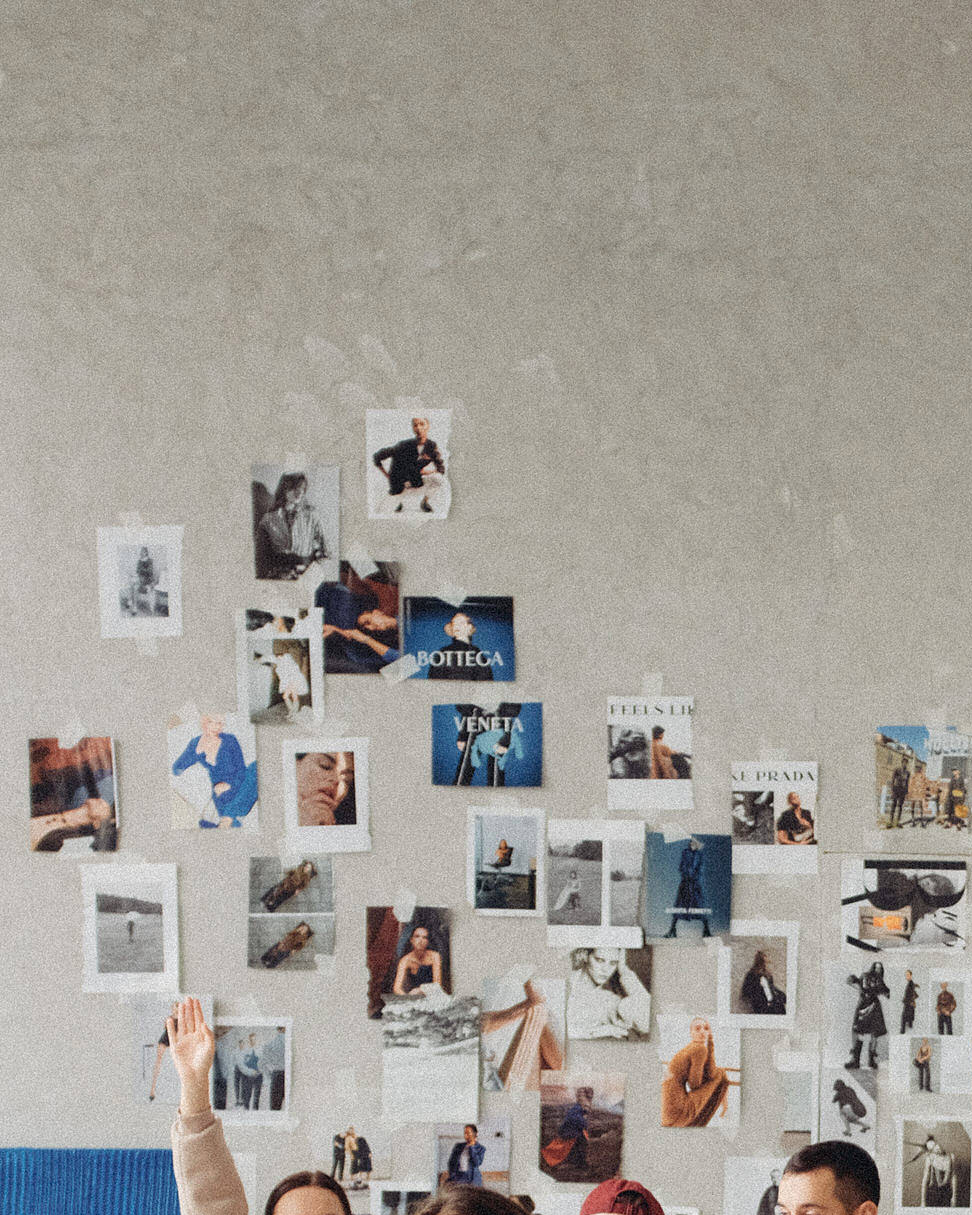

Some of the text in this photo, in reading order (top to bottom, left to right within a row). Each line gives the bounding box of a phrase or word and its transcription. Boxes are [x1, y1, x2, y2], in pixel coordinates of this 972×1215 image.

[417, 650, 504, 667] BOTTEGA
[453, 716, 524, 733] VENETA
[757, 770, 815, 781] PRADA
